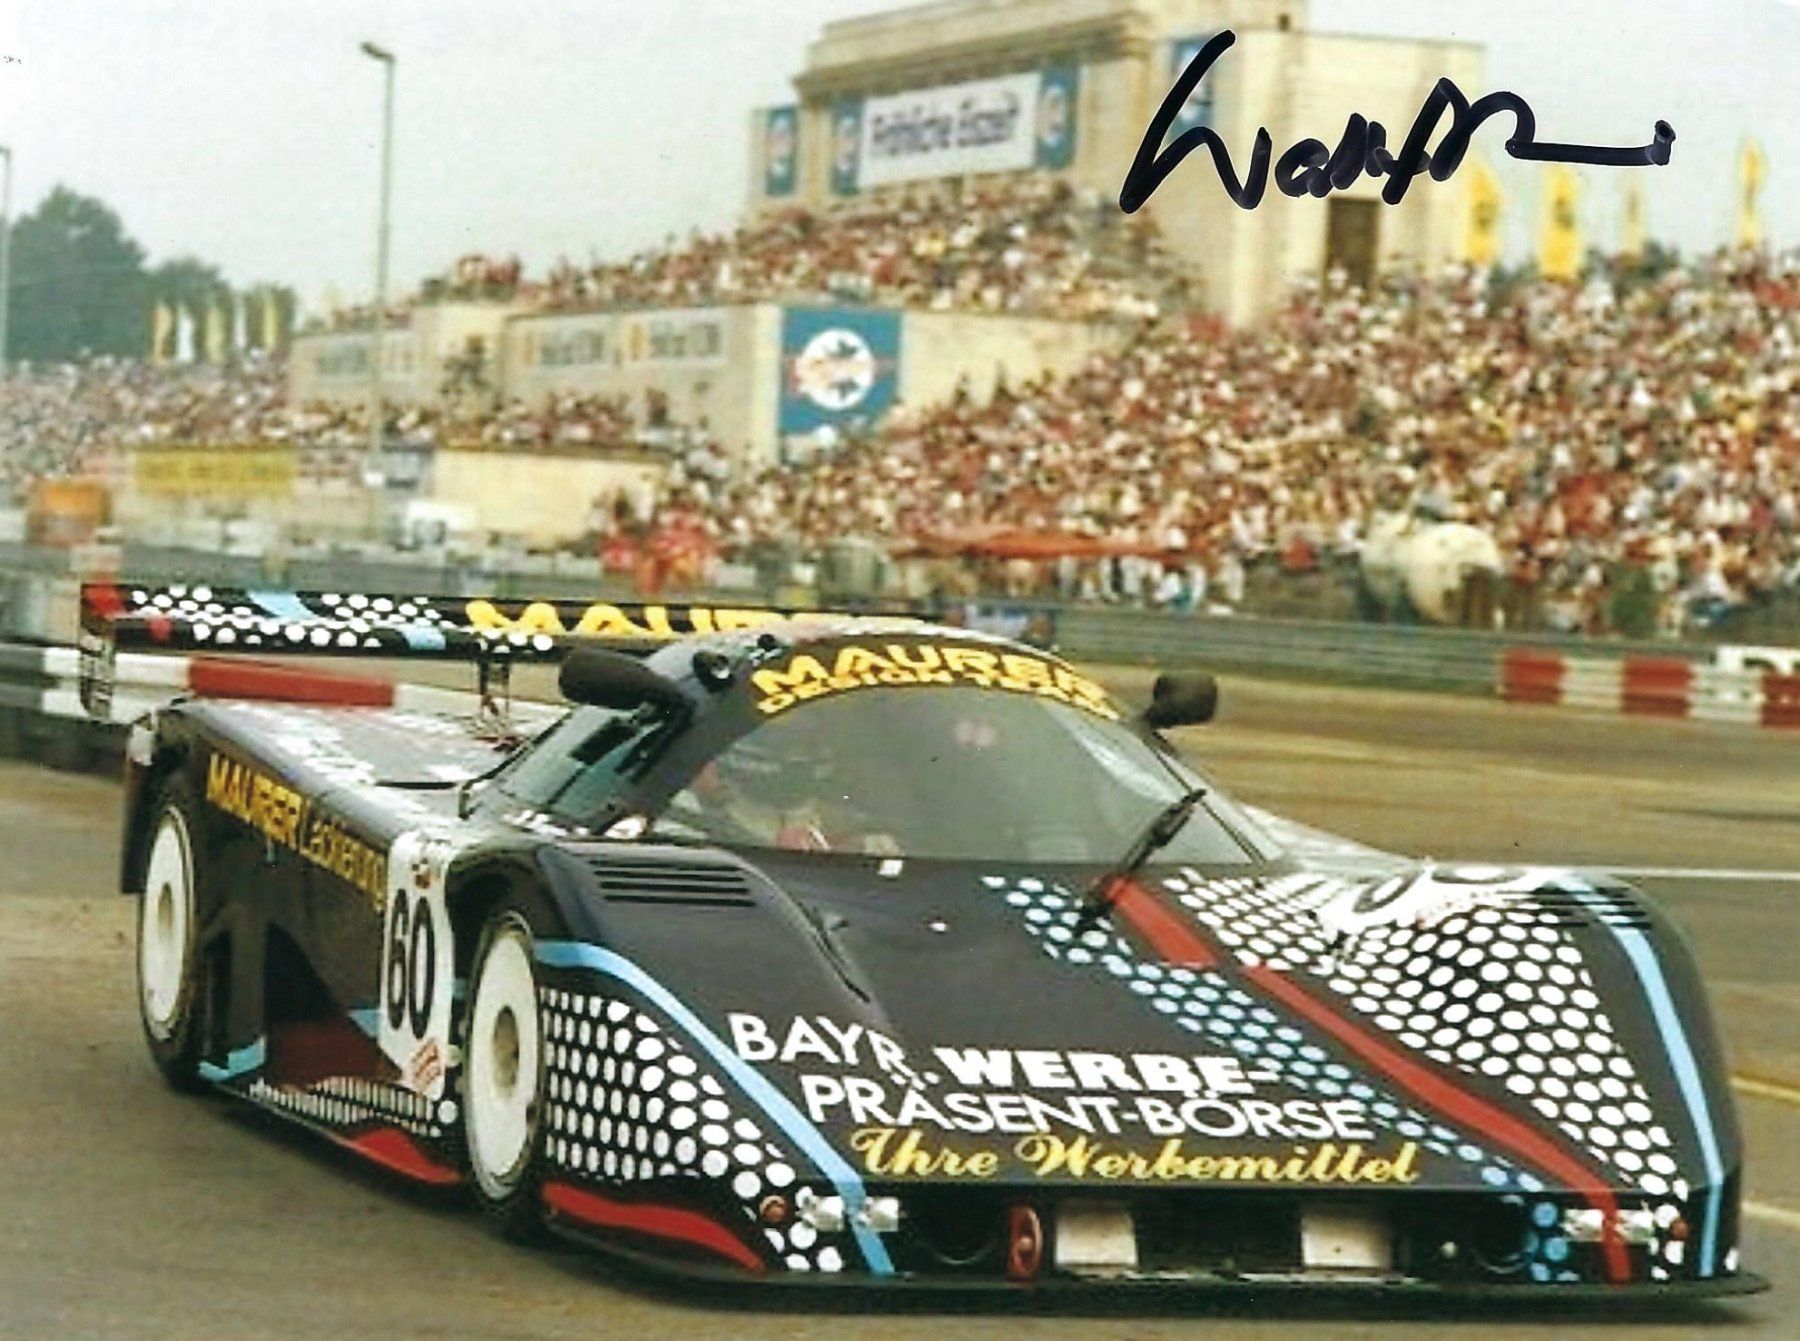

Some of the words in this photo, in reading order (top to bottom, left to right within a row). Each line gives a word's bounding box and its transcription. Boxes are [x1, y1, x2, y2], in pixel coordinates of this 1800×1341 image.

[752, 645, 1108, 704] MAURER
[206, 752, 304, 851] MAURER
[386, 888, 436, 1040] 60
[728, 1012, 941, 1086] BAYR.
[934, 1046, 1280, 1095] WERBE-
[799, 1073, 1376, 1141] PRÄSENT-BÖRSE
[1013, 1131, 1421, 1184] Werbemittel
